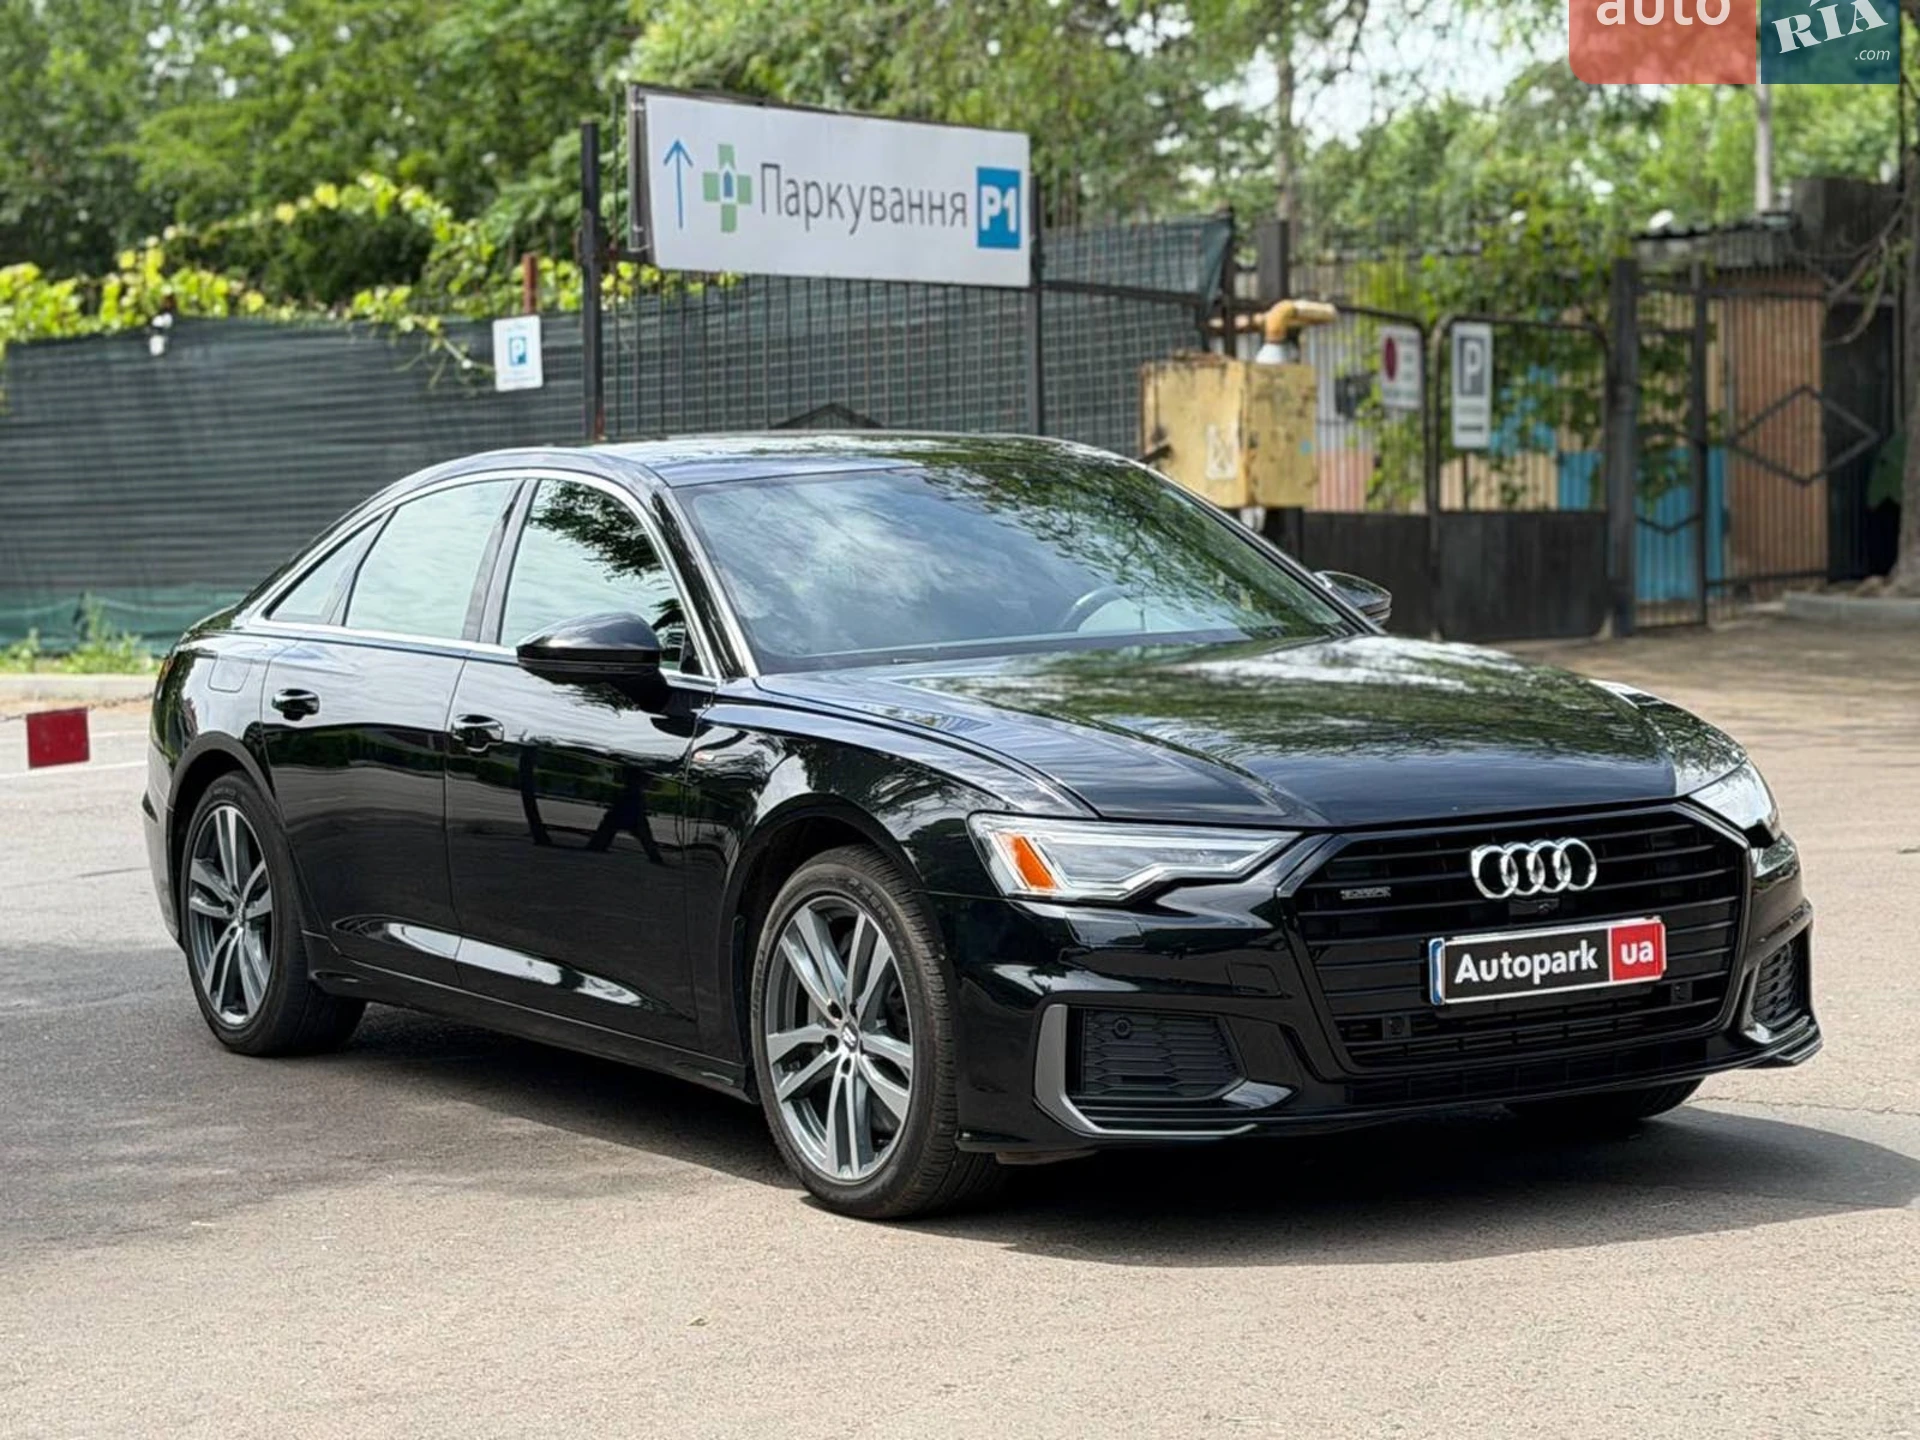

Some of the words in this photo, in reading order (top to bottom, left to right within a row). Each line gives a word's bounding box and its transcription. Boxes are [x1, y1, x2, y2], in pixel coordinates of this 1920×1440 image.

[760, 162, 968, 236] Паркування
[981, 185, 1017, 233] P1
[1454, 939, 1599, 985] Autopark
[1620, 940, 1654, 965] ua
